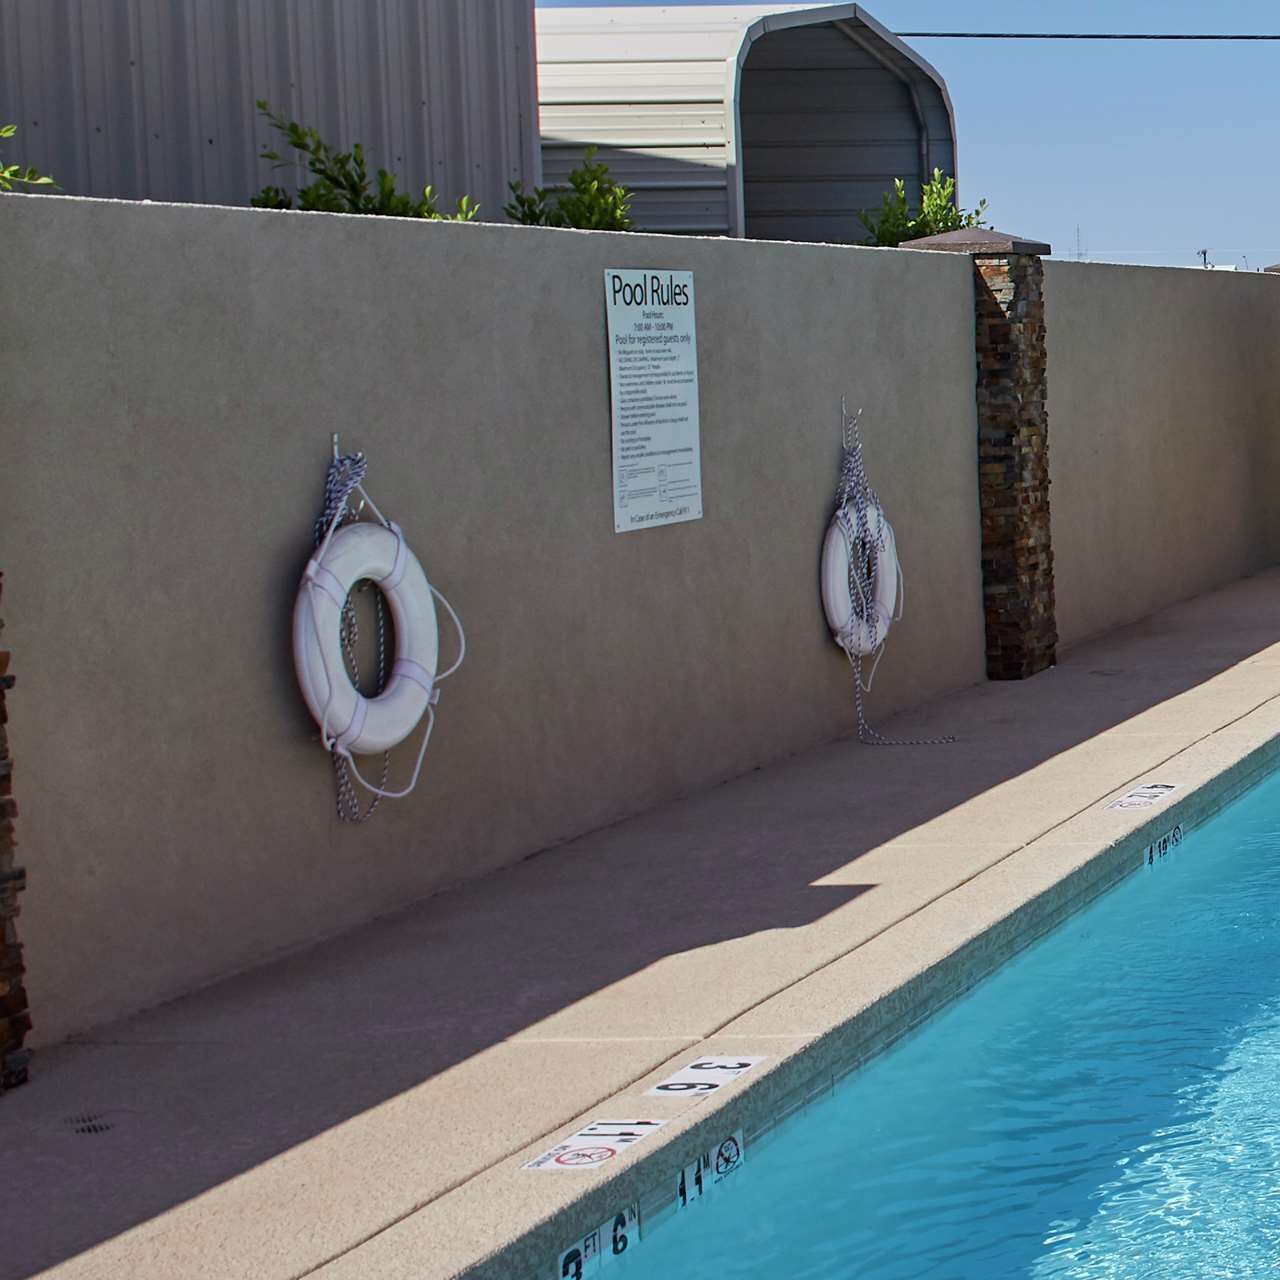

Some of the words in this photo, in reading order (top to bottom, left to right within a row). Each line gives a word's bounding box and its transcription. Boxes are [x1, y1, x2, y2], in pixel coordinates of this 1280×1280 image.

[612, 274, 648, 306] Pool
[651, 274, 689, 306] Rules
[615, 334, 628, 345] Pool
[628, 334, 636, 345] for
[637, 334, 663, 347] registered
[664, 335, 679, 346] guests
[680, 333, 691, 345] only
[690, 1061, 751, 1071] 3
[656, 1082, 720, 1092] 6
[583, 1231, 598, 1258] FT
[612, 1212, 629, 1255] 6
